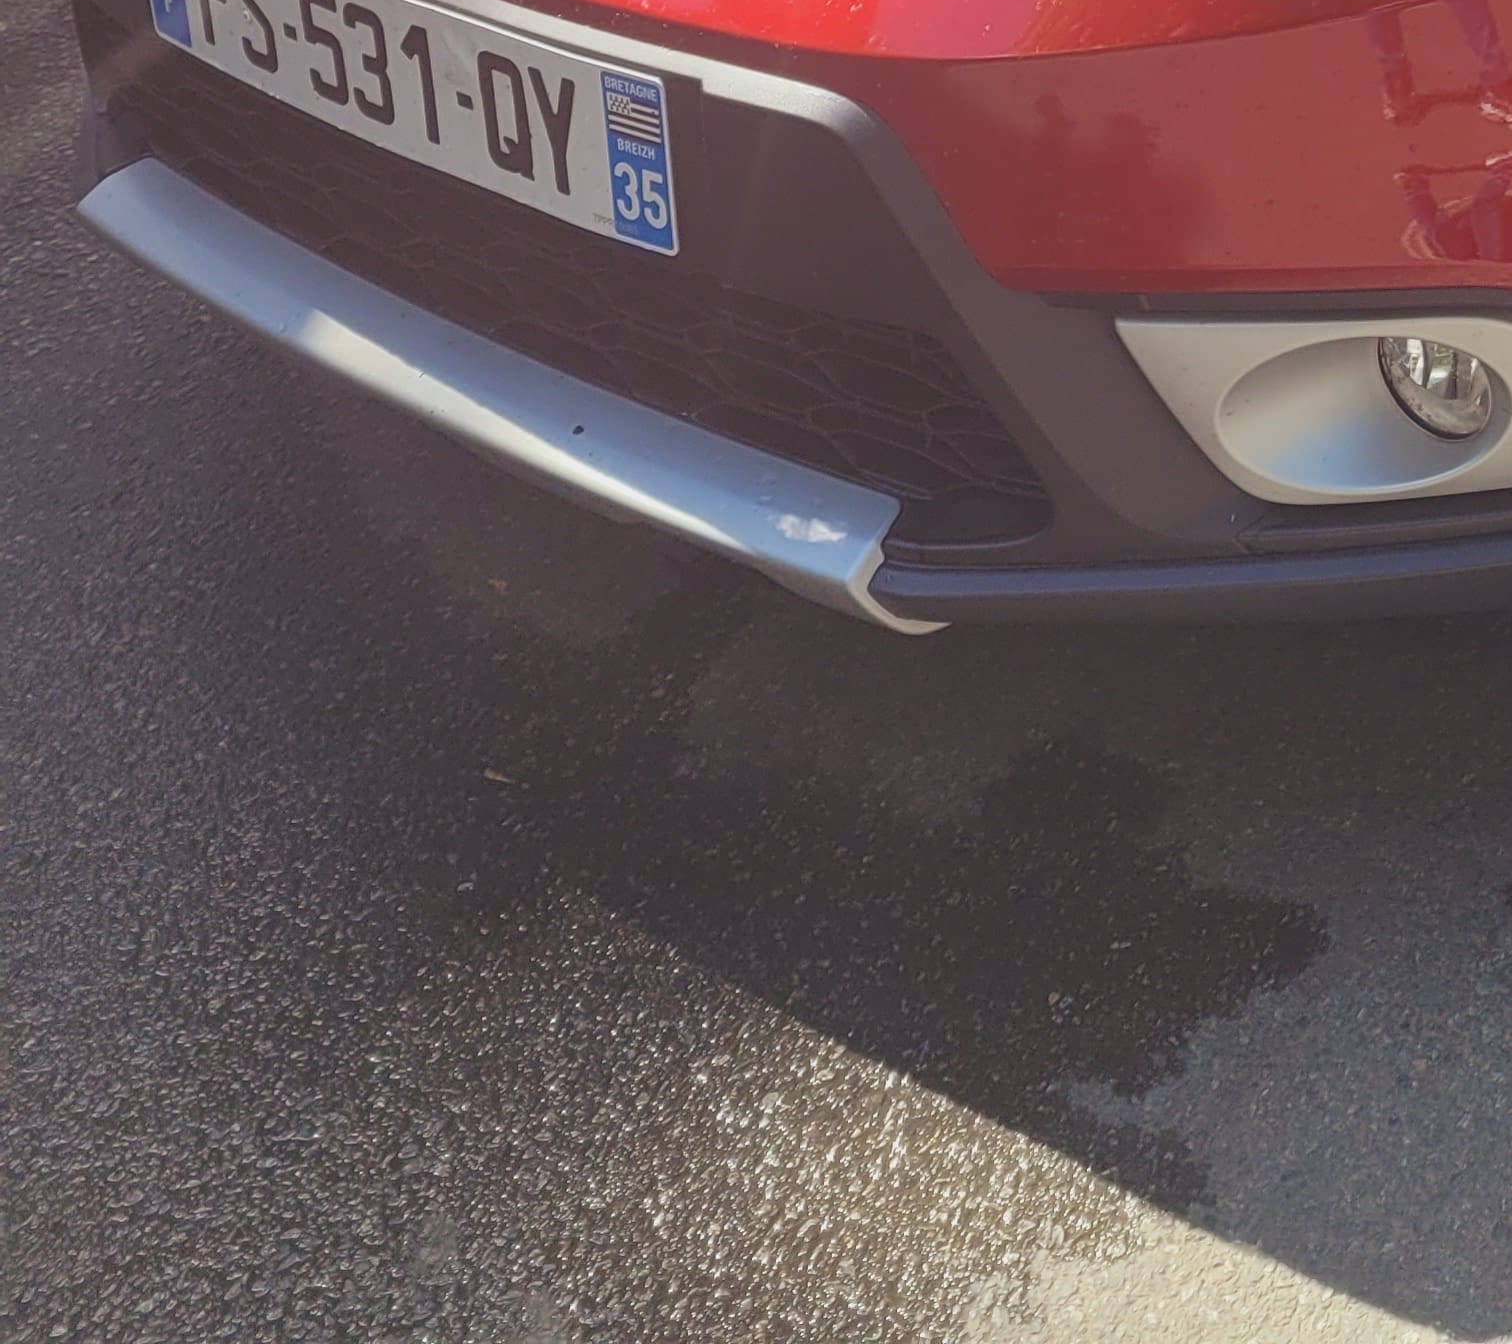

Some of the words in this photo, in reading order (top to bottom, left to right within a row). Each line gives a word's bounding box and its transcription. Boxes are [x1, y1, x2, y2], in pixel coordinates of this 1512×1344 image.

[604, 75, 658, 103] BRETAGNE
[616, 137, 656, 161] BREIZH
[613, 161, 669, 230] 35
